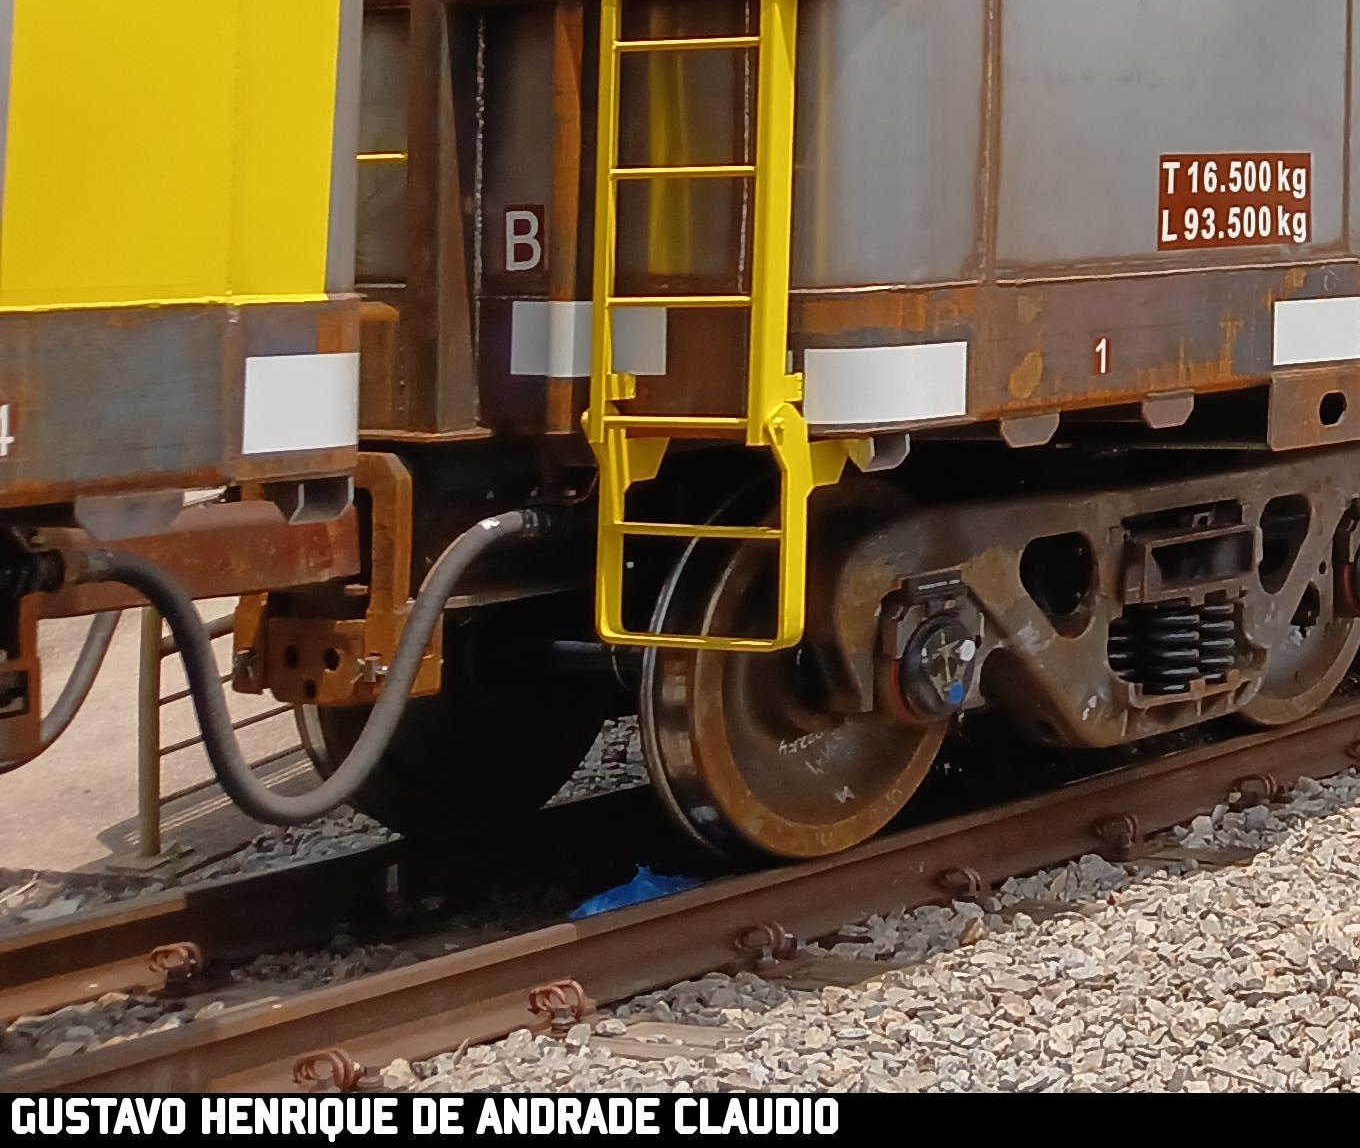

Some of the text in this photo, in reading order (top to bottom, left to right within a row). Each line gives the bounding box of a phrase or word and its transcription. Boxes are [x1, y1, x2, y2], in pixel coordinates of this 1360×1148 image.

[1162, 161, 1306, 199] T 16.500 kg
[504, 209, 542, 272] B
[1161, 205, 1307, 243] L 93.500 kg
[1095, 336, 1109, 374] 1
